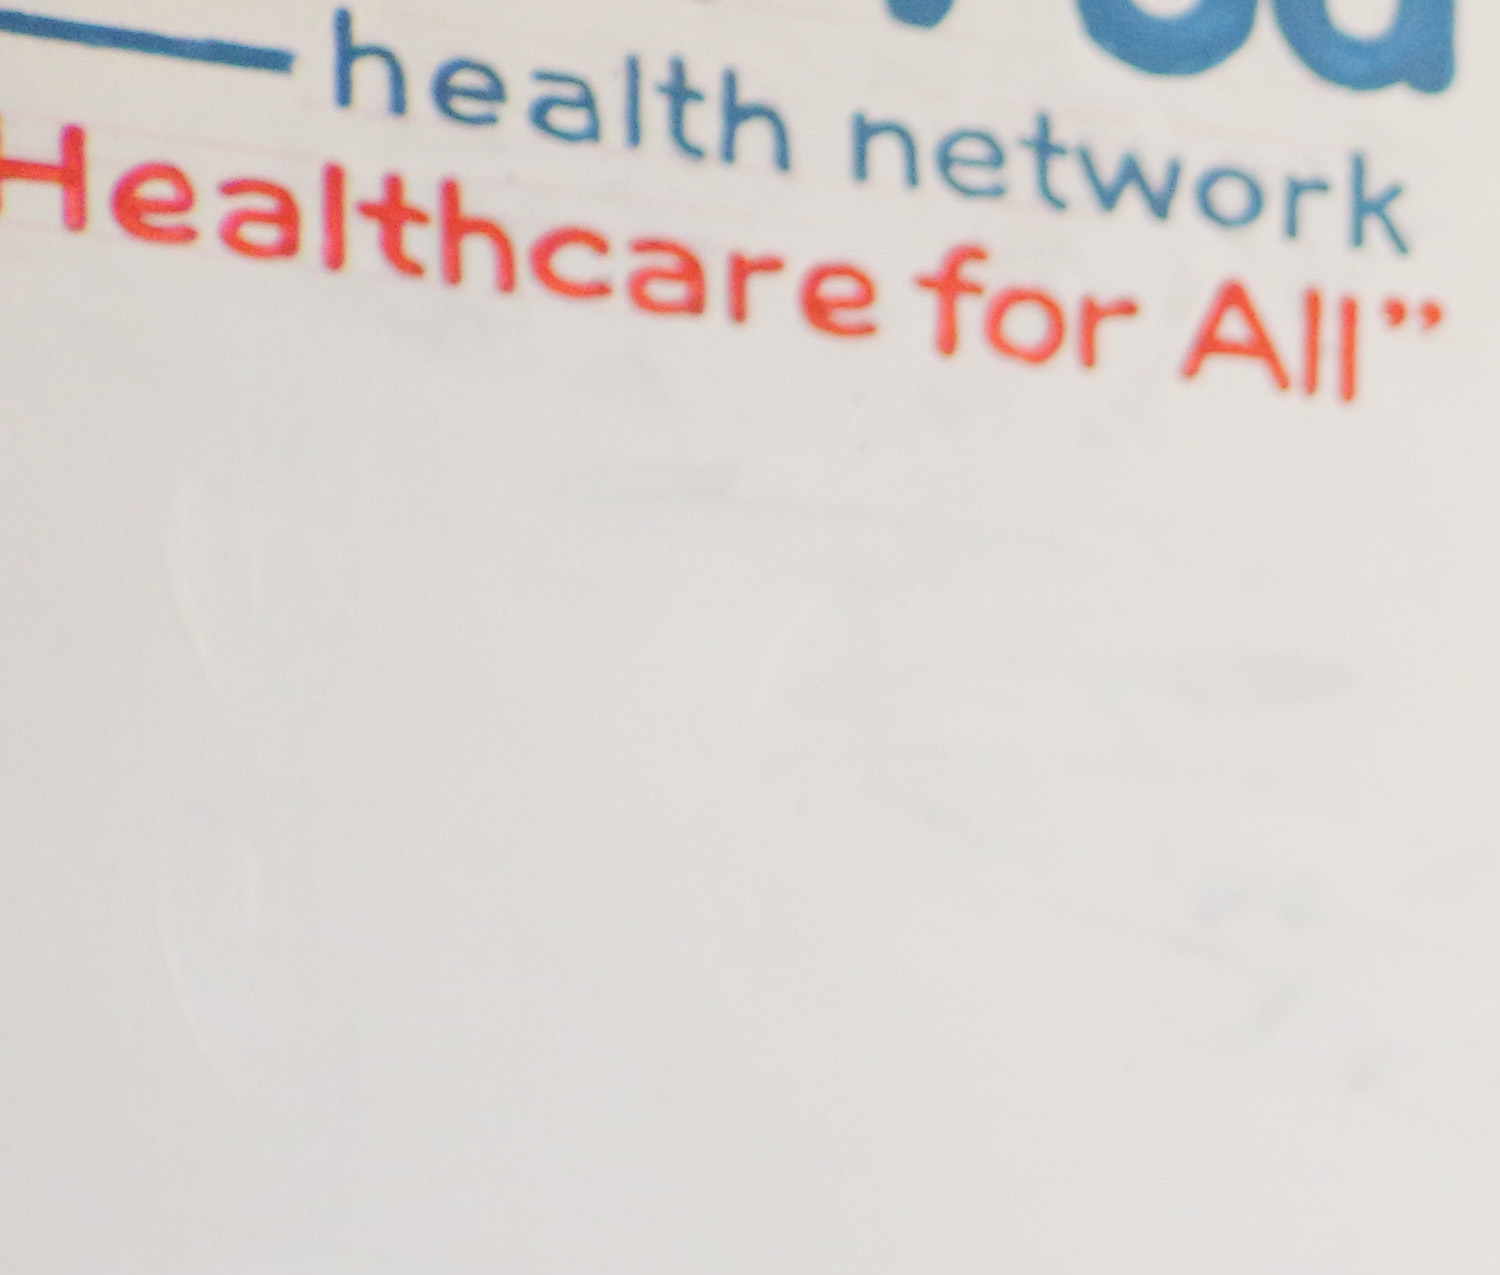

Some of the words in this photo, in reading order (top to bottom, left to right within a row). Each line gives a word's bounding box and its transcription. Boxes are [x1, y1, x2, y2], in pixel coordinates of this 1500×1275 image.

[0, 113, 880, 340] Healthcare
[914, 242, 1142, 372] for
[332, 7, 792, 172] health
[851, 112, 1408, 254] network
